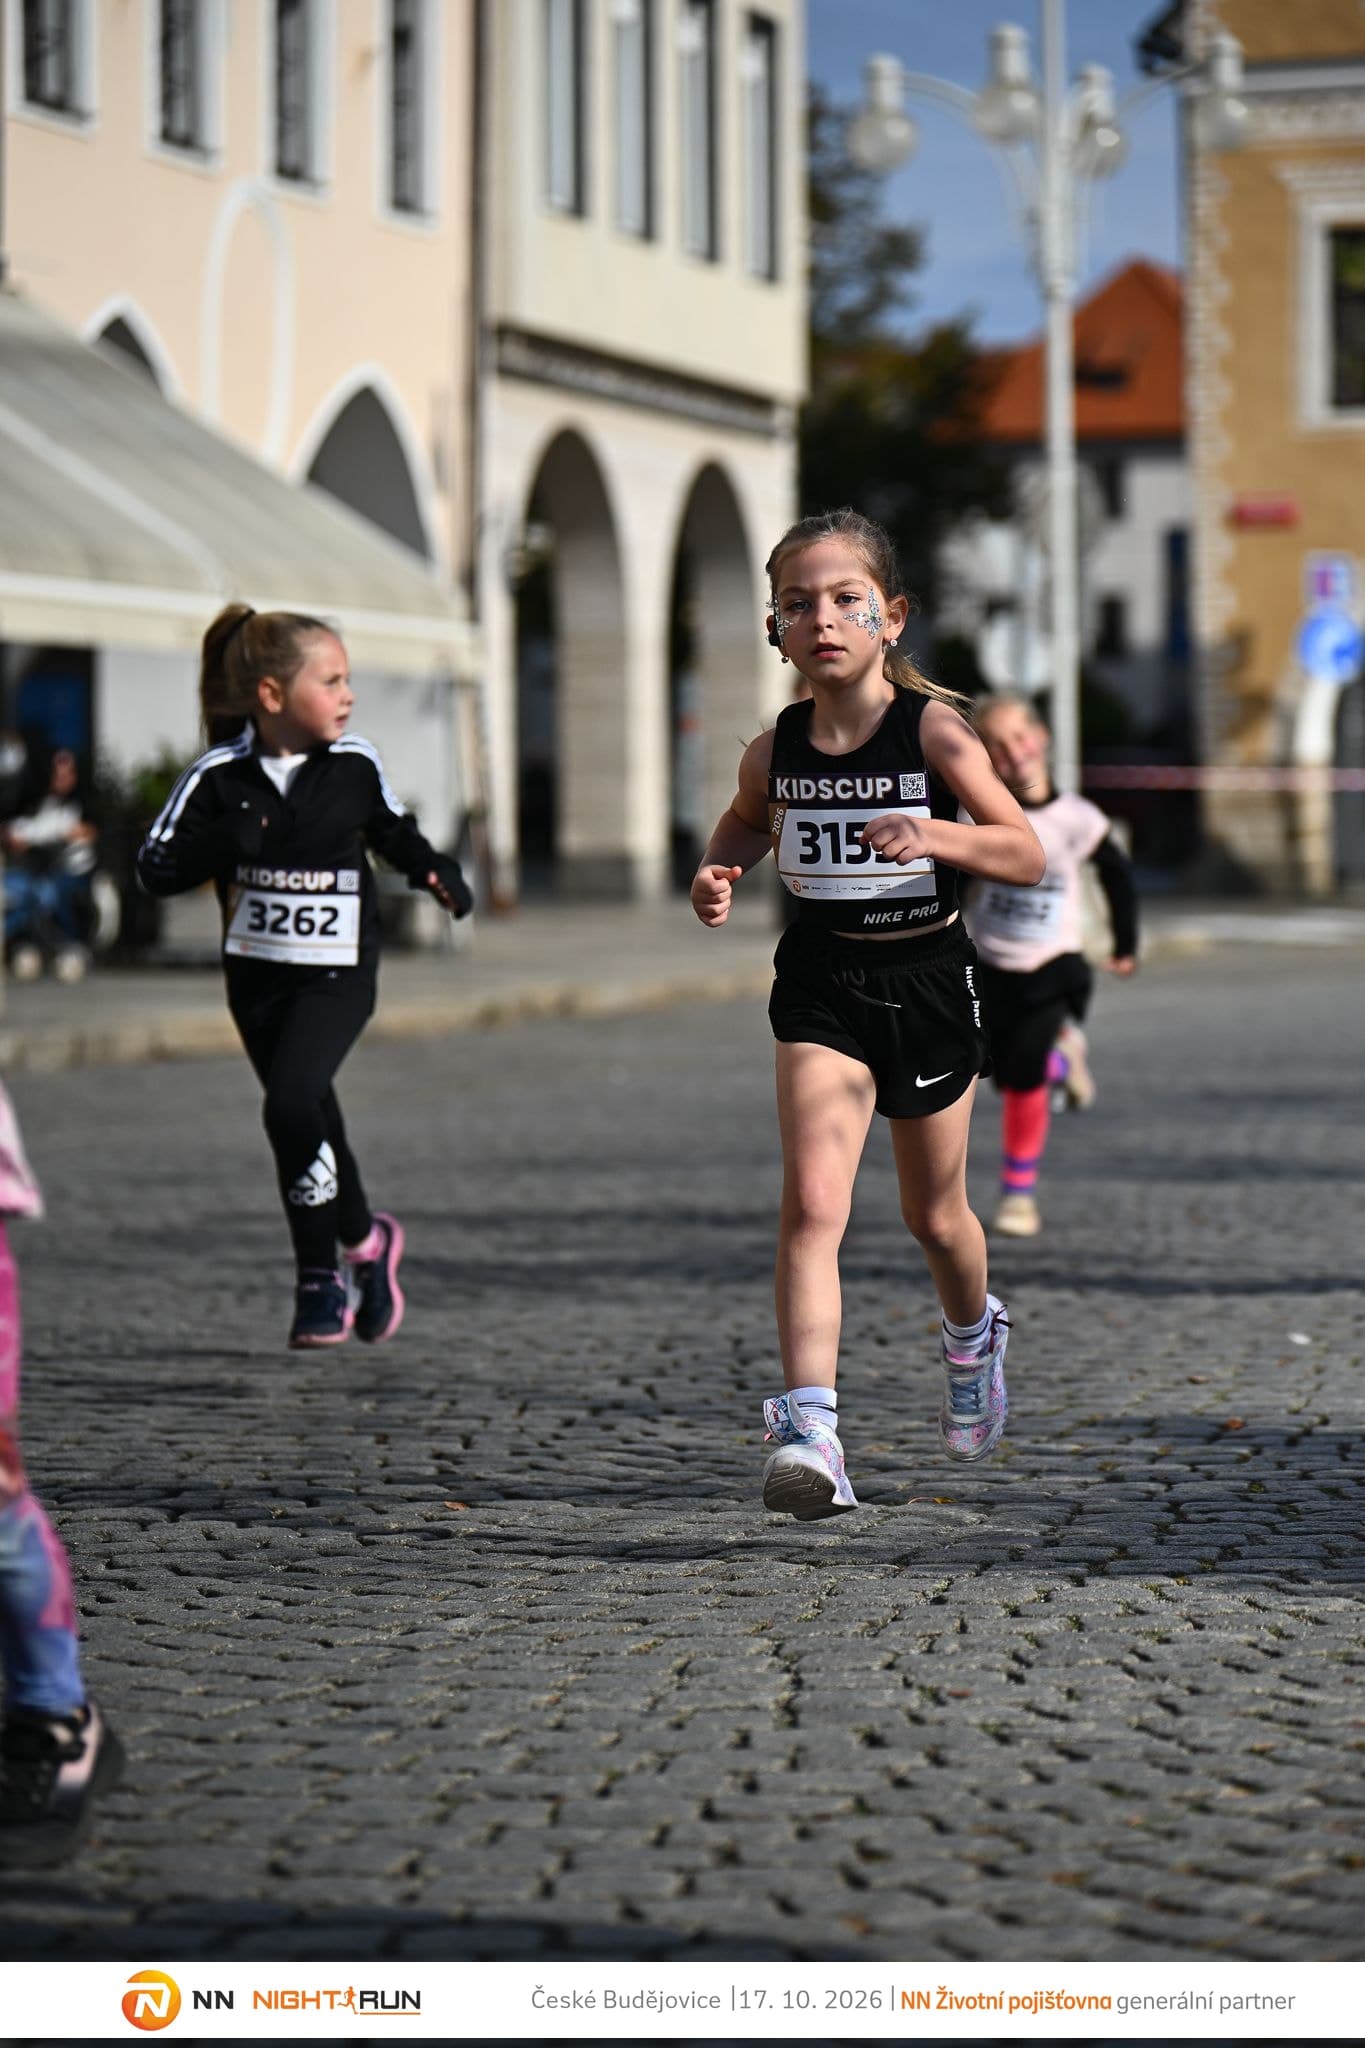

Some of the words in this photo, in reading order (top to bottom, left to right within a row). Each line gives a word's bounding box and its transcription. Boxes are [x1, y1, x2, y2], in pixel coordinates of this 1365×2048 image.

[776, 777, 893, 800] KIDSCUP
[772, 807, 784, 836] 2026
[796, 821, 898, 864] 315
[236, 865, 335, 891] KIDSCUP
[247, 899, 339, 937] 3262
[863, 911, 904, 925] NIKE
[908, 902, 939, 920] PRO
